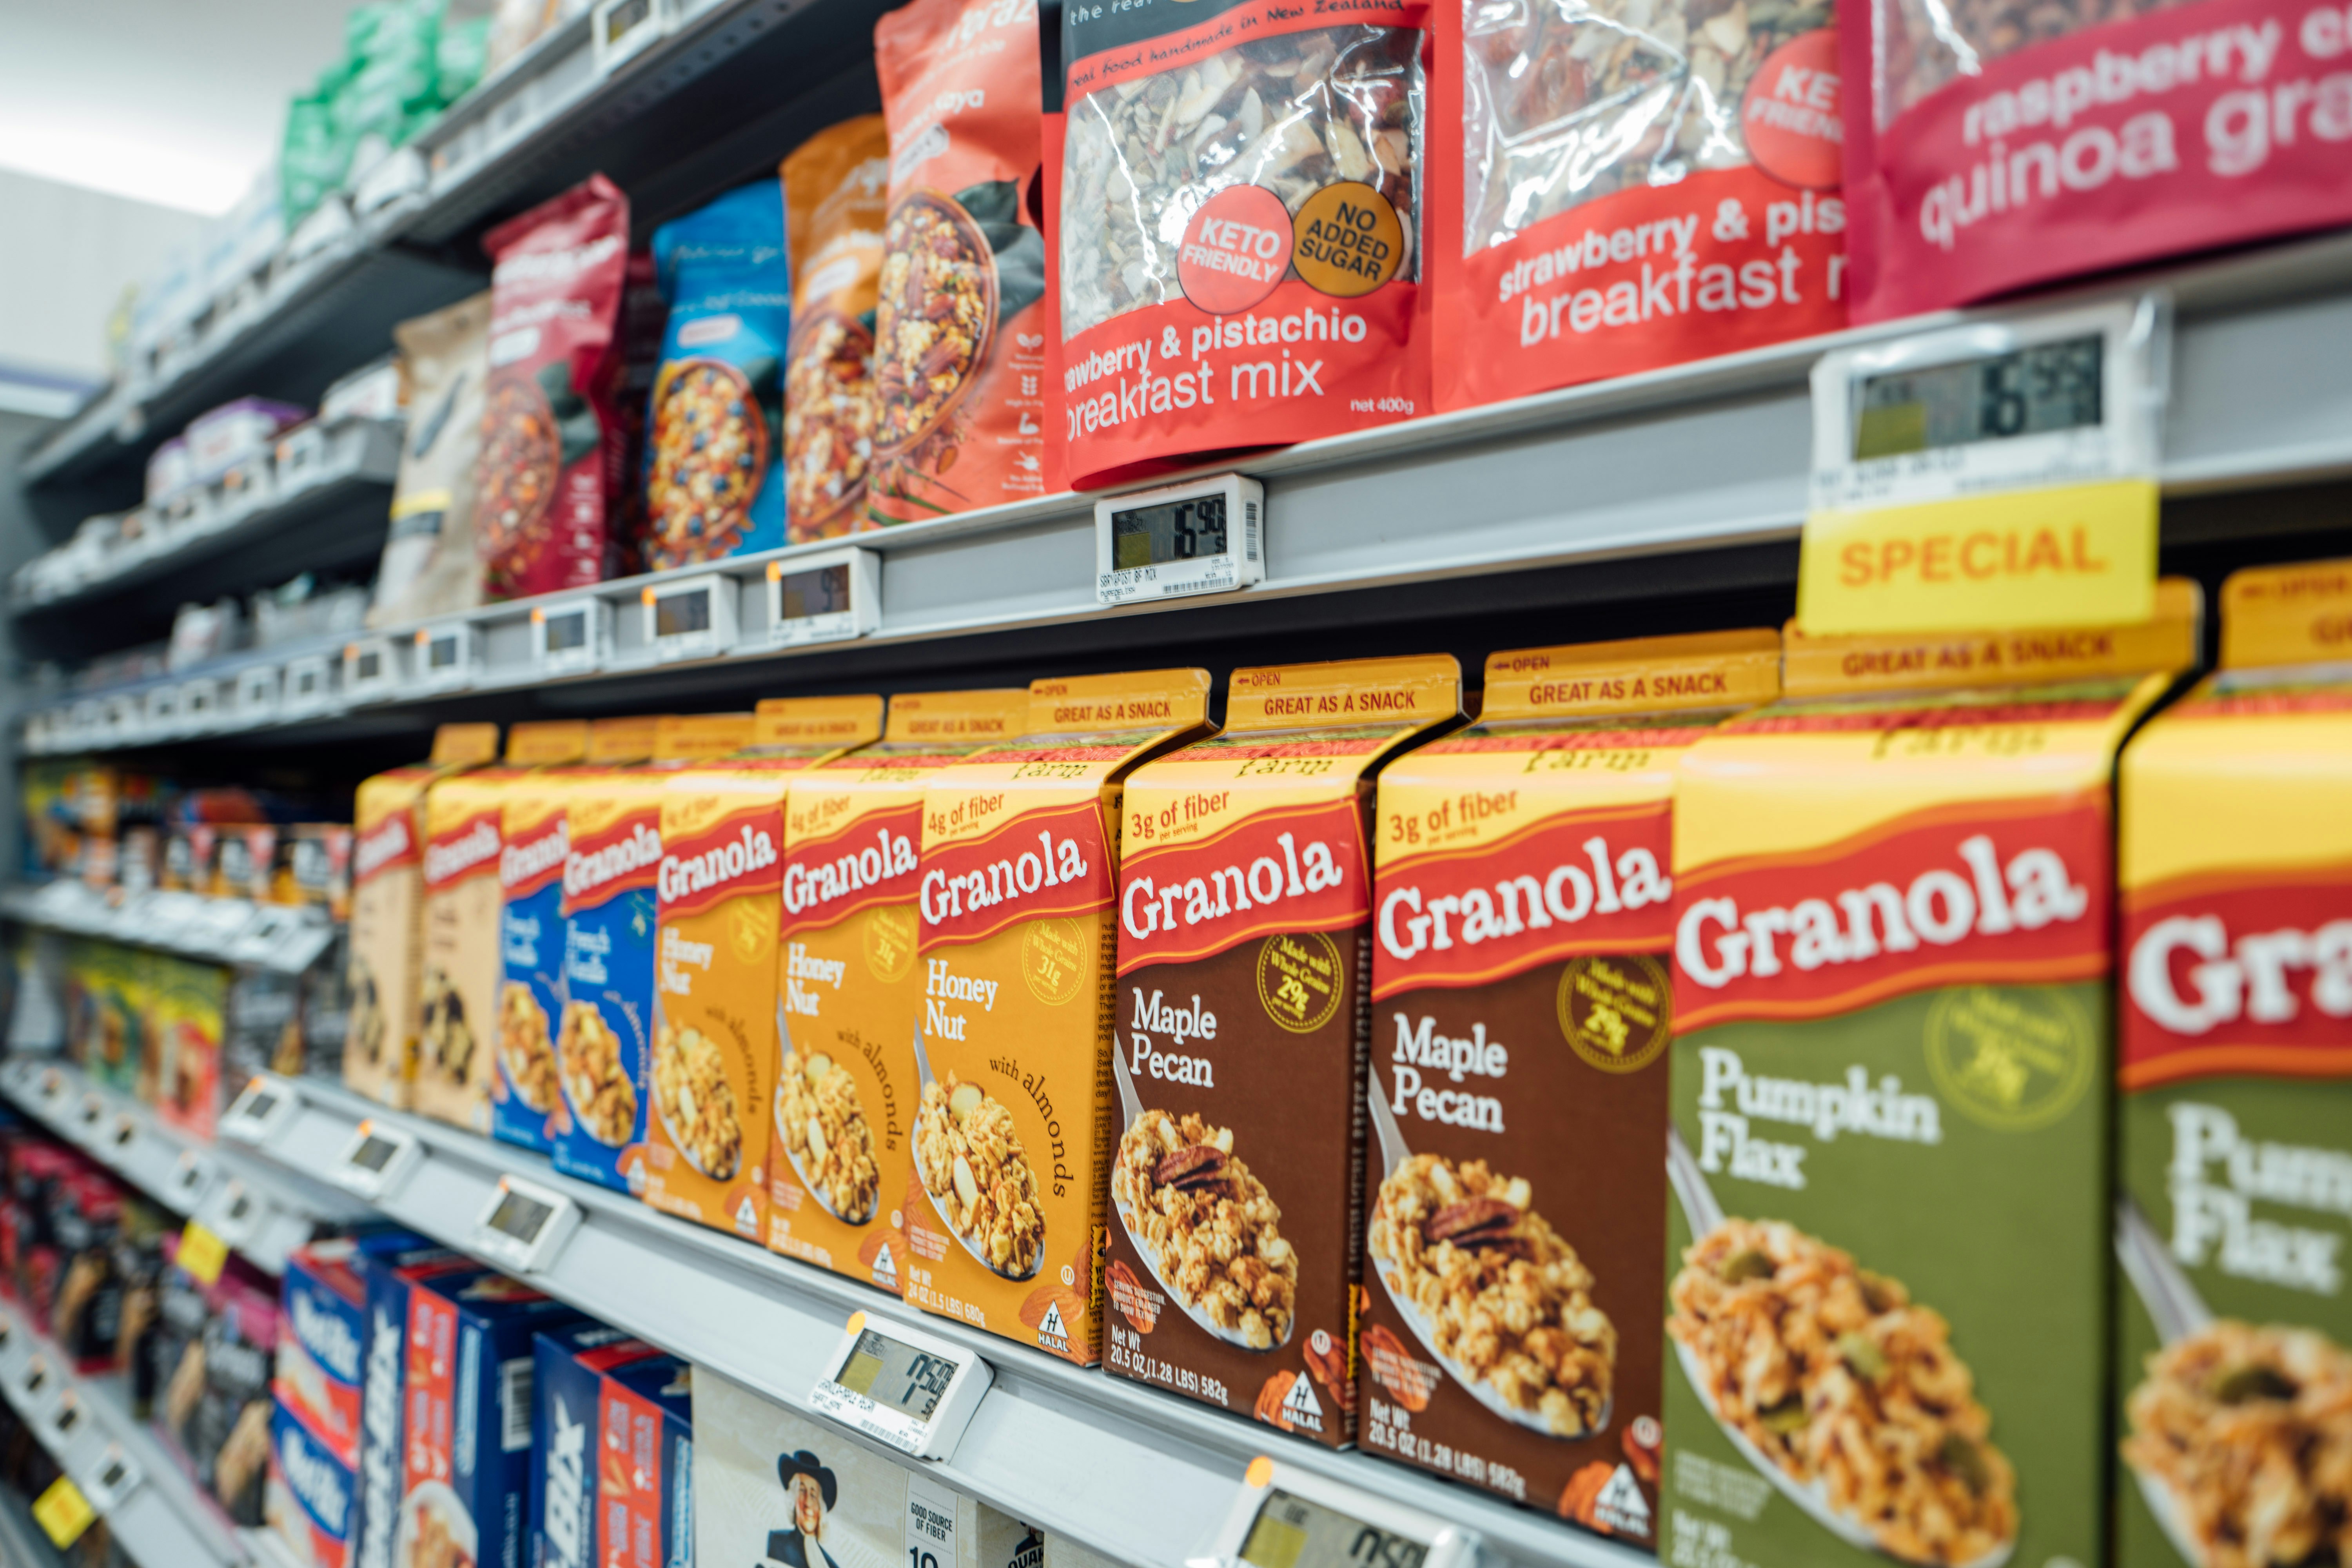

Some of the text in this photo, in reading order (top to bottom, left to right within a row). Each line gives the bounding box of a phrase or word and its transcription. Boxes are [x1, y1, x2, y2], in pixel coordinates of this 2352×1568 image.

[1070, 4, 1102, 26] the
[1103, 49, 1142, 78] food
[1149, 23, 1234, 62] handmade
[1240, 14, 1258, 30] in
[1267, 3, 1305, 22] New
[1962, 18, 2281, 147] raspberry
[1919, 111, 2180, 252] quinoa
[1336, 201, 1377, 231] NO
[1199, 216, 1281, 260] KETO
[1299, 238, 1383, 281] SUGAR
[1306, 220, 1390, 261] ADDED
[1499, 212, 1699, 303] strawberry
[1711, 198, 1748, 241] &
[1181, 245, 1279, 283] FRIENDLY
[1520, 245, 1802, 347] breakfast
[1160, 307, 1367, 361] & pistachio
[1232, 349, 1324, 401] mix
[1350, 396, 1414, 416] net 400g
[1838, 525, 2107, 589] SPECIAL
[1512, 657, 1550, 672] OPEN
[1841, 634, 2113, 678] GREAT AS A SNACK
[1044, 685, 1067, 696] OPEN
[1252, 672, 1281, 687] OPEN
[1529, 673, 1727, 705] GREAT AS A SNACK
[1054, 701, 1171, 723] GREAT AS A SNACK
[1264, 691, 1416, 717] GREAT AS A SNACK
[908, 720, 939, 734] GREAT
[969, 719, 1005, 733] SNACK
[927, 793, 1005, 835] 4g of fiber
[1131, 790, 1230, 840] 3g of fiber
[1159, 822, 1198, 843] per serving
[1390, 789, 1519, 844] 3g of fiber
[563, 822, 663, 897] Granola
[658, 824, 777, 903] Granola
[783, 828, 918, 915] Granola
[920, 829, 1087, 926] Granola
[1122, 831, 1343, 940] Granola
[1377, 836, 1673, 960] Granola
[1040, 921, 1060, 944] Made
[1674, 833, 2089, 989] Granola
[786, 941, 846, 990] Honey
[1033, 934, 1077, 972] Whole Grains
[1037, 955, 1062, 987] 31g
[785, 977, 820, 1017] Nut
[926, 958, 998, 1012] Honey
[1276, 974, 1310, 1012] 29g
[924, 998, 967, 1041] Nut
[1098, 1033, 1110, 1042] you
[1131, 987, 1218, 1045] Maple
[1130, 1032, 1214, 1088] Pecan
[1392, 1012, 1508, 1082] Maple
[1096, 1089, 1111, 1099] day!
[1097, 1070, 1109, 1078] this
[1697, 1045, 1943, 1145] Pumpkin
[862, 1041, 904, 1152] almonds
[1392, 1064, 1505, 1134] Pecan
[989, 1057, 1074, 1198] with almonds
[1697, 1109, 1807, 1190] Flax
[908, 1281, 917, 1299] 24
[919, 1285, 929, 1304] OZ
[946, 1296, 964, 1319] LBS)
[964, 1303, 986, 1328] 680g
[1113, 1291, 1161, 1314] PRODUCT ENLARGED
[1113, 1301, 1157, 1325] TO SHOW TEXTURE
[1114, 1279, 1166, 1306] SERVING SUGGESTION.
[1038, 1333, 1070, 1354] HALAL
[1112, 1323, 1126, 1347] Net
[1128, 1329, 1141, 1352] Wt
[1111, 1343, 1229, 1406] 20.5 OZ (1.28 LBS) 582g
[1282, 1407, 1324, 1432] HALAL
[1369, 1397, 1410, 1431] Net Wt
[1369, 1421, 1396, 1450] 20.5
[1398, 1432, 1417, 1457] OZ
[1454, 1450, 1486, 1482] LBS)
[911, 1501, 953, 1532] GOOD SOURCE
[916, 1518, 946, 1543] OF FIBER
